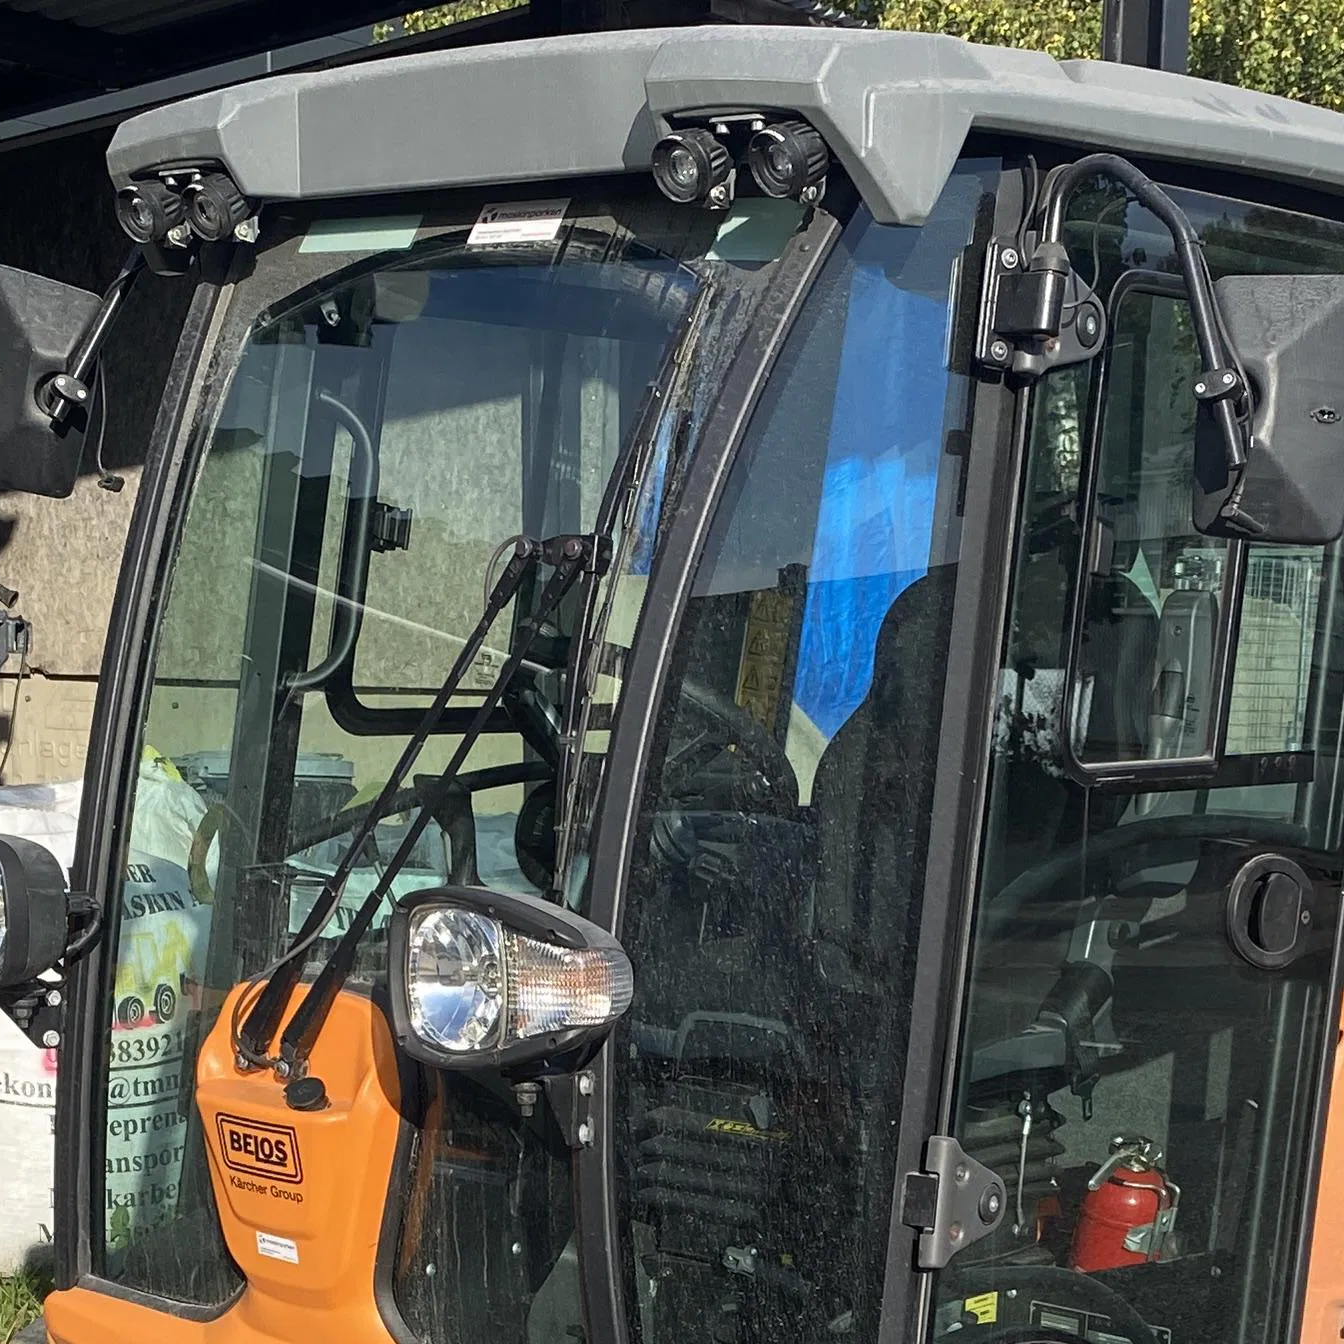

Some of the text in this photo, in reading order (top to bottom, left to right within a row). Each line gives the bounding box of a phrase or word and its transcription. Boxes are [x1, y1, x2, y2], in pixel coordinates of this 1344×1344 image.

[229, 1129, 288, 1167] BELOS
[229, 1175, 304, 1204] Kärcher Group
